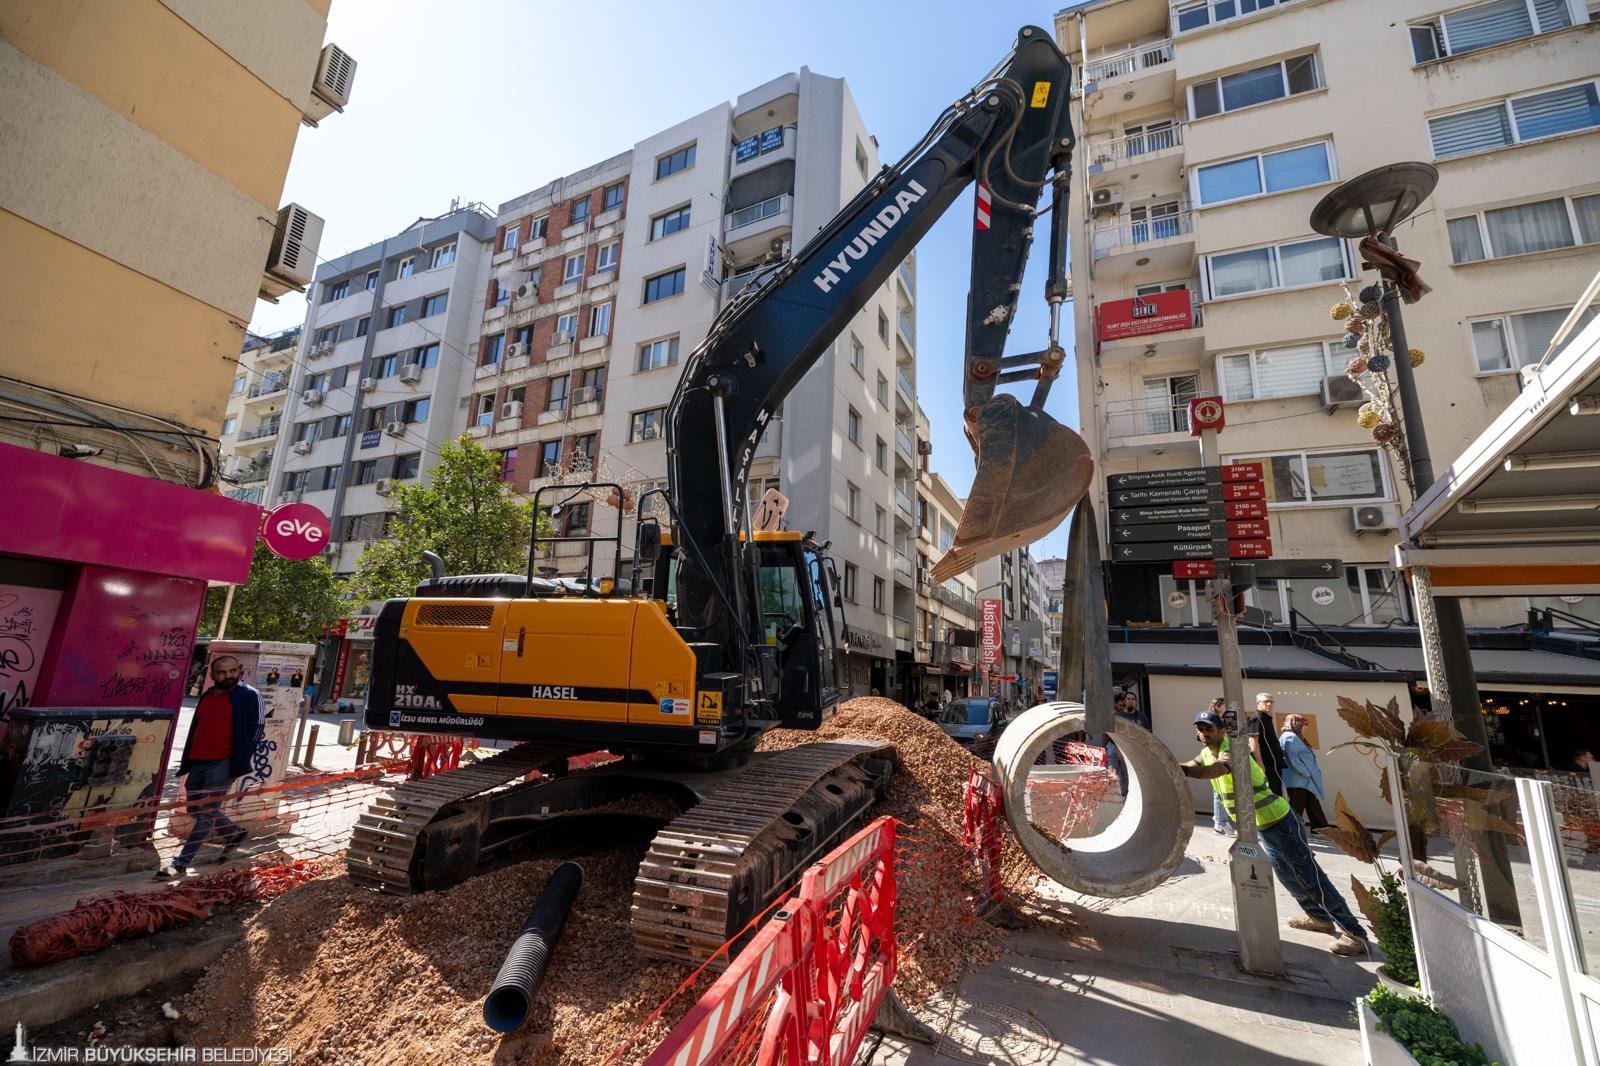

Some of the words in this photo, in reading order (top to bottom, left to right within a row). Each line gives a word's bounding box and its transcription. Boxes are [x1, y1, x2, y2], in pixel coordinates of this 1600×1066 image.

[813, 179, 928, 293] HYUNDAI
[277, 519, 322, 542] eve
[1177, 524, 1211, 532] Pasaport
[1173, 543, 1213, 551] Kültürpark
[395, 685, 415, 694] HX
[532, 685, 578, 700] HASEL
[400, 714, 417, 723] İZSU
[417, 716, 438, 724] GENEL
[439, 716, 484, 726] MÜDÜRLÜĞÜ
